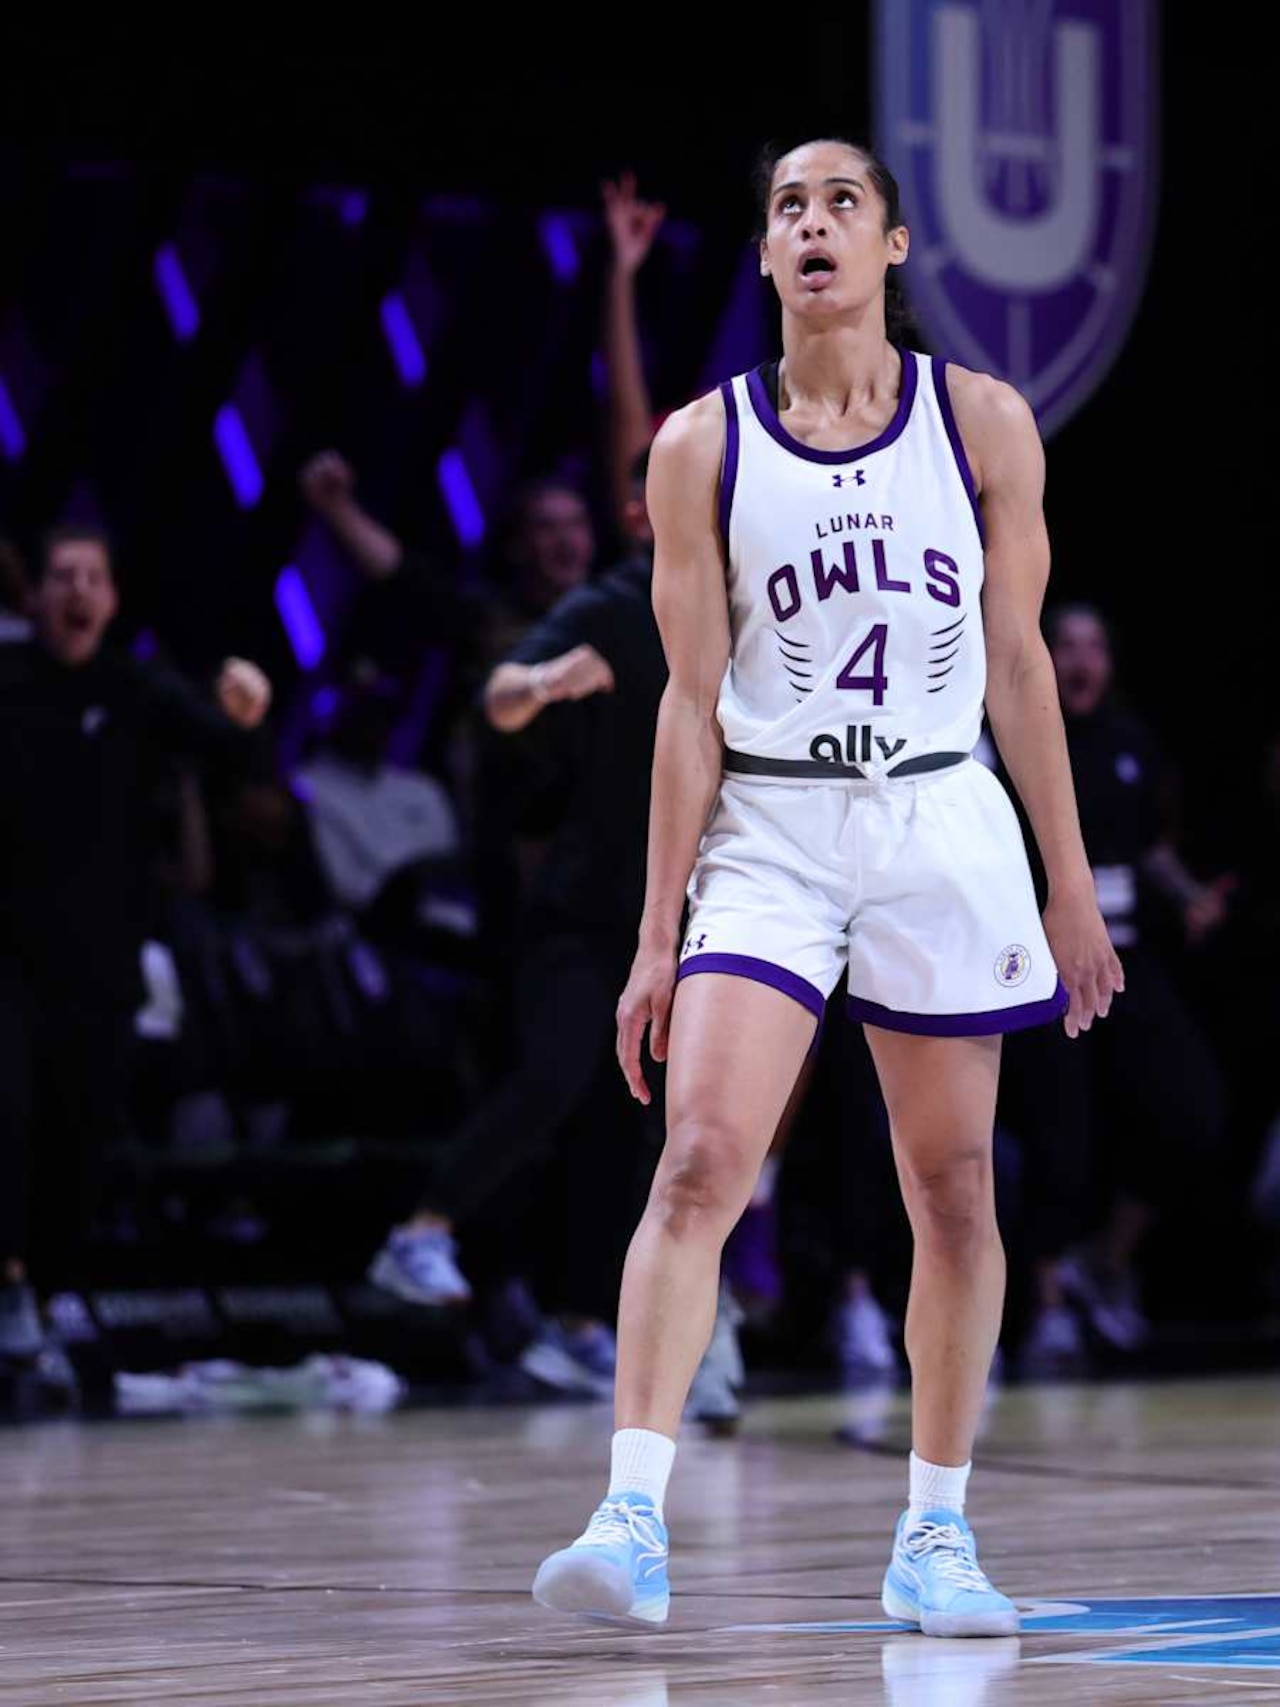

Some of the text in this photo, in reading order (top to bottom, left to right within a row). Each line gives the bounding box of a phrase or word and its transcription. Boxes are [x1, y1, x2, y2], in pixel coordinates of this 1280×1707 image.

[935, 7, 1097, 288] U
[815, 512, 894, 539] LUNAR
[767, 539, 961, 622] OWLS
[835, 624, 888, 706] 4
